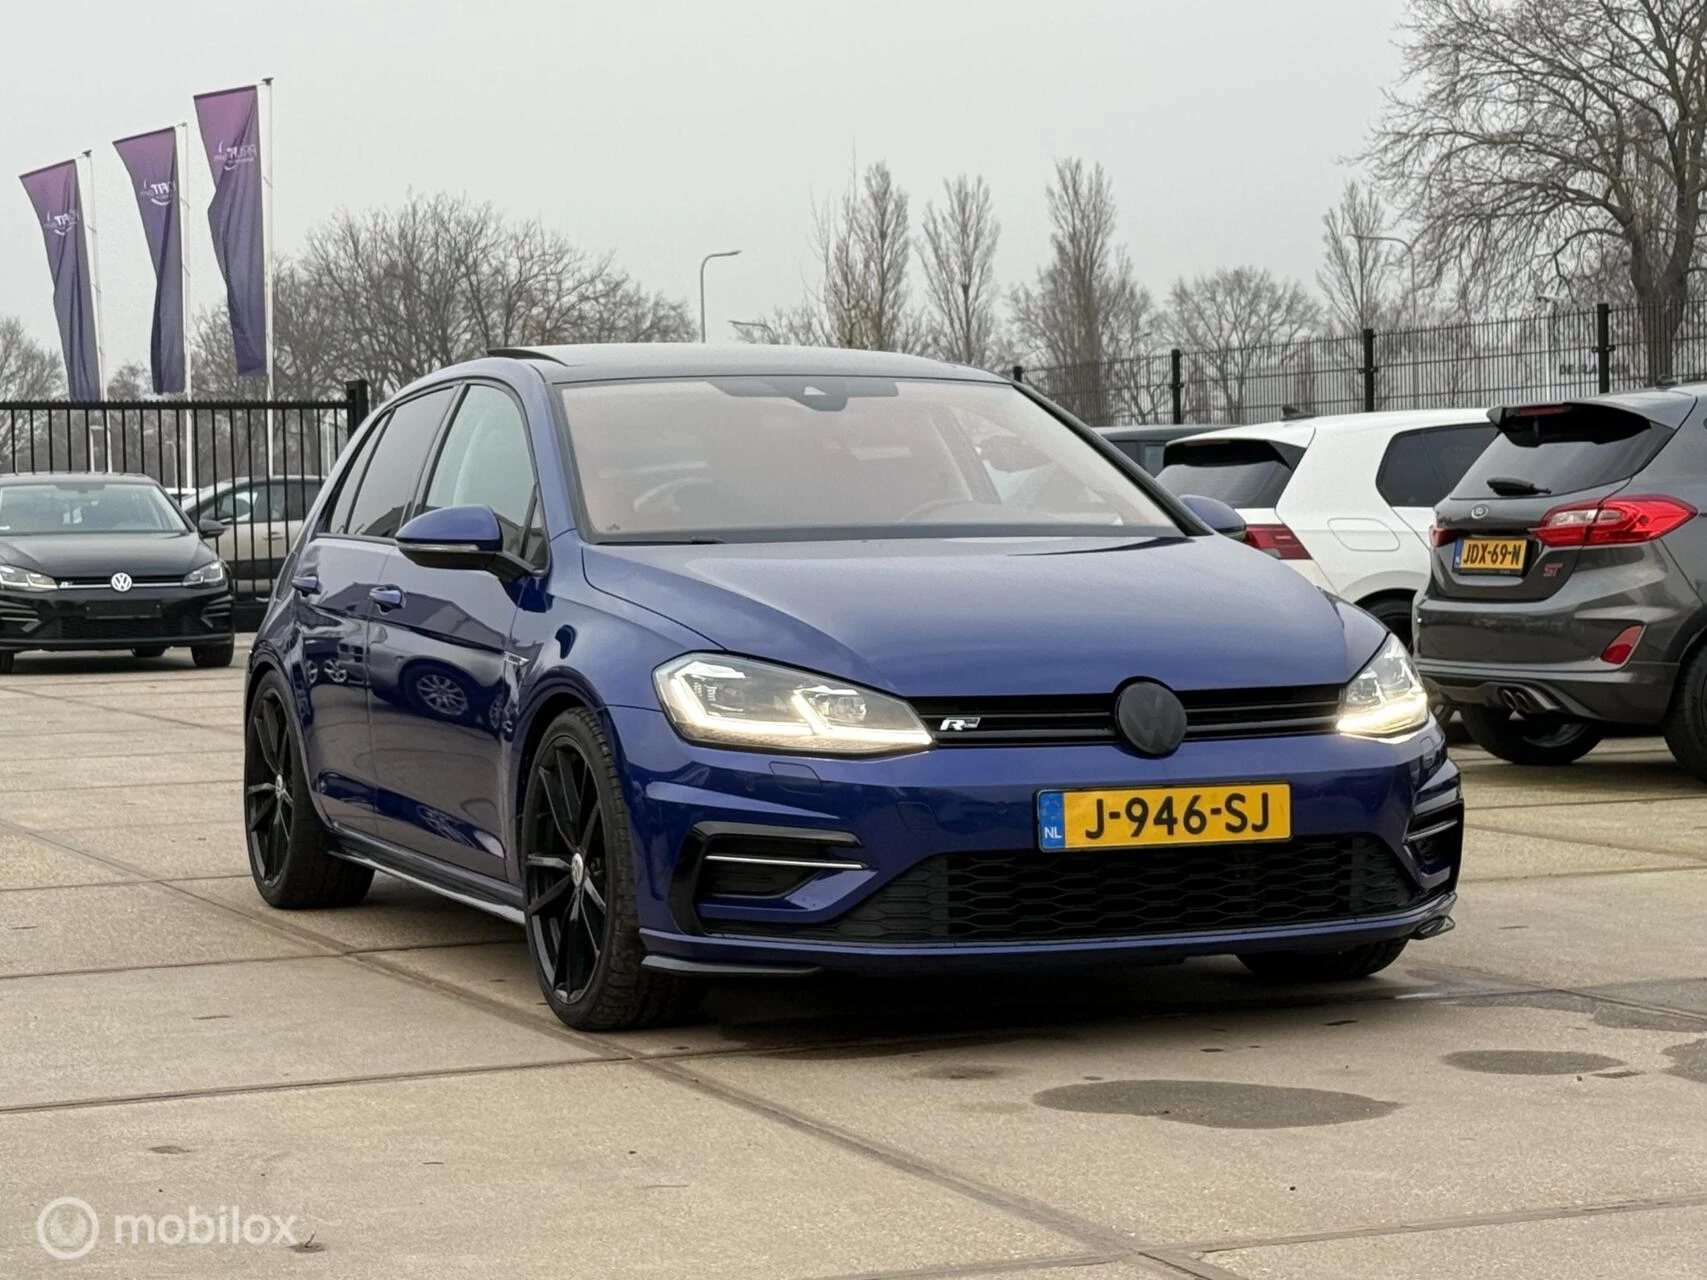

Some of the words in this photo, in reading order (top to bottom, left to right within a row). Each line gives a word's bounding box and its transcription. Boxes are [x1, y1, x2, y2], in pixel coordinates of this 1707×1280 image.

[1463, 543, 1522, 566] JDX-69-N
[1543, 562, 1565, 577] ST
[1044, 826, 1063, 839] NL
[1085, 793, 1270, 840] J-946-SJ
